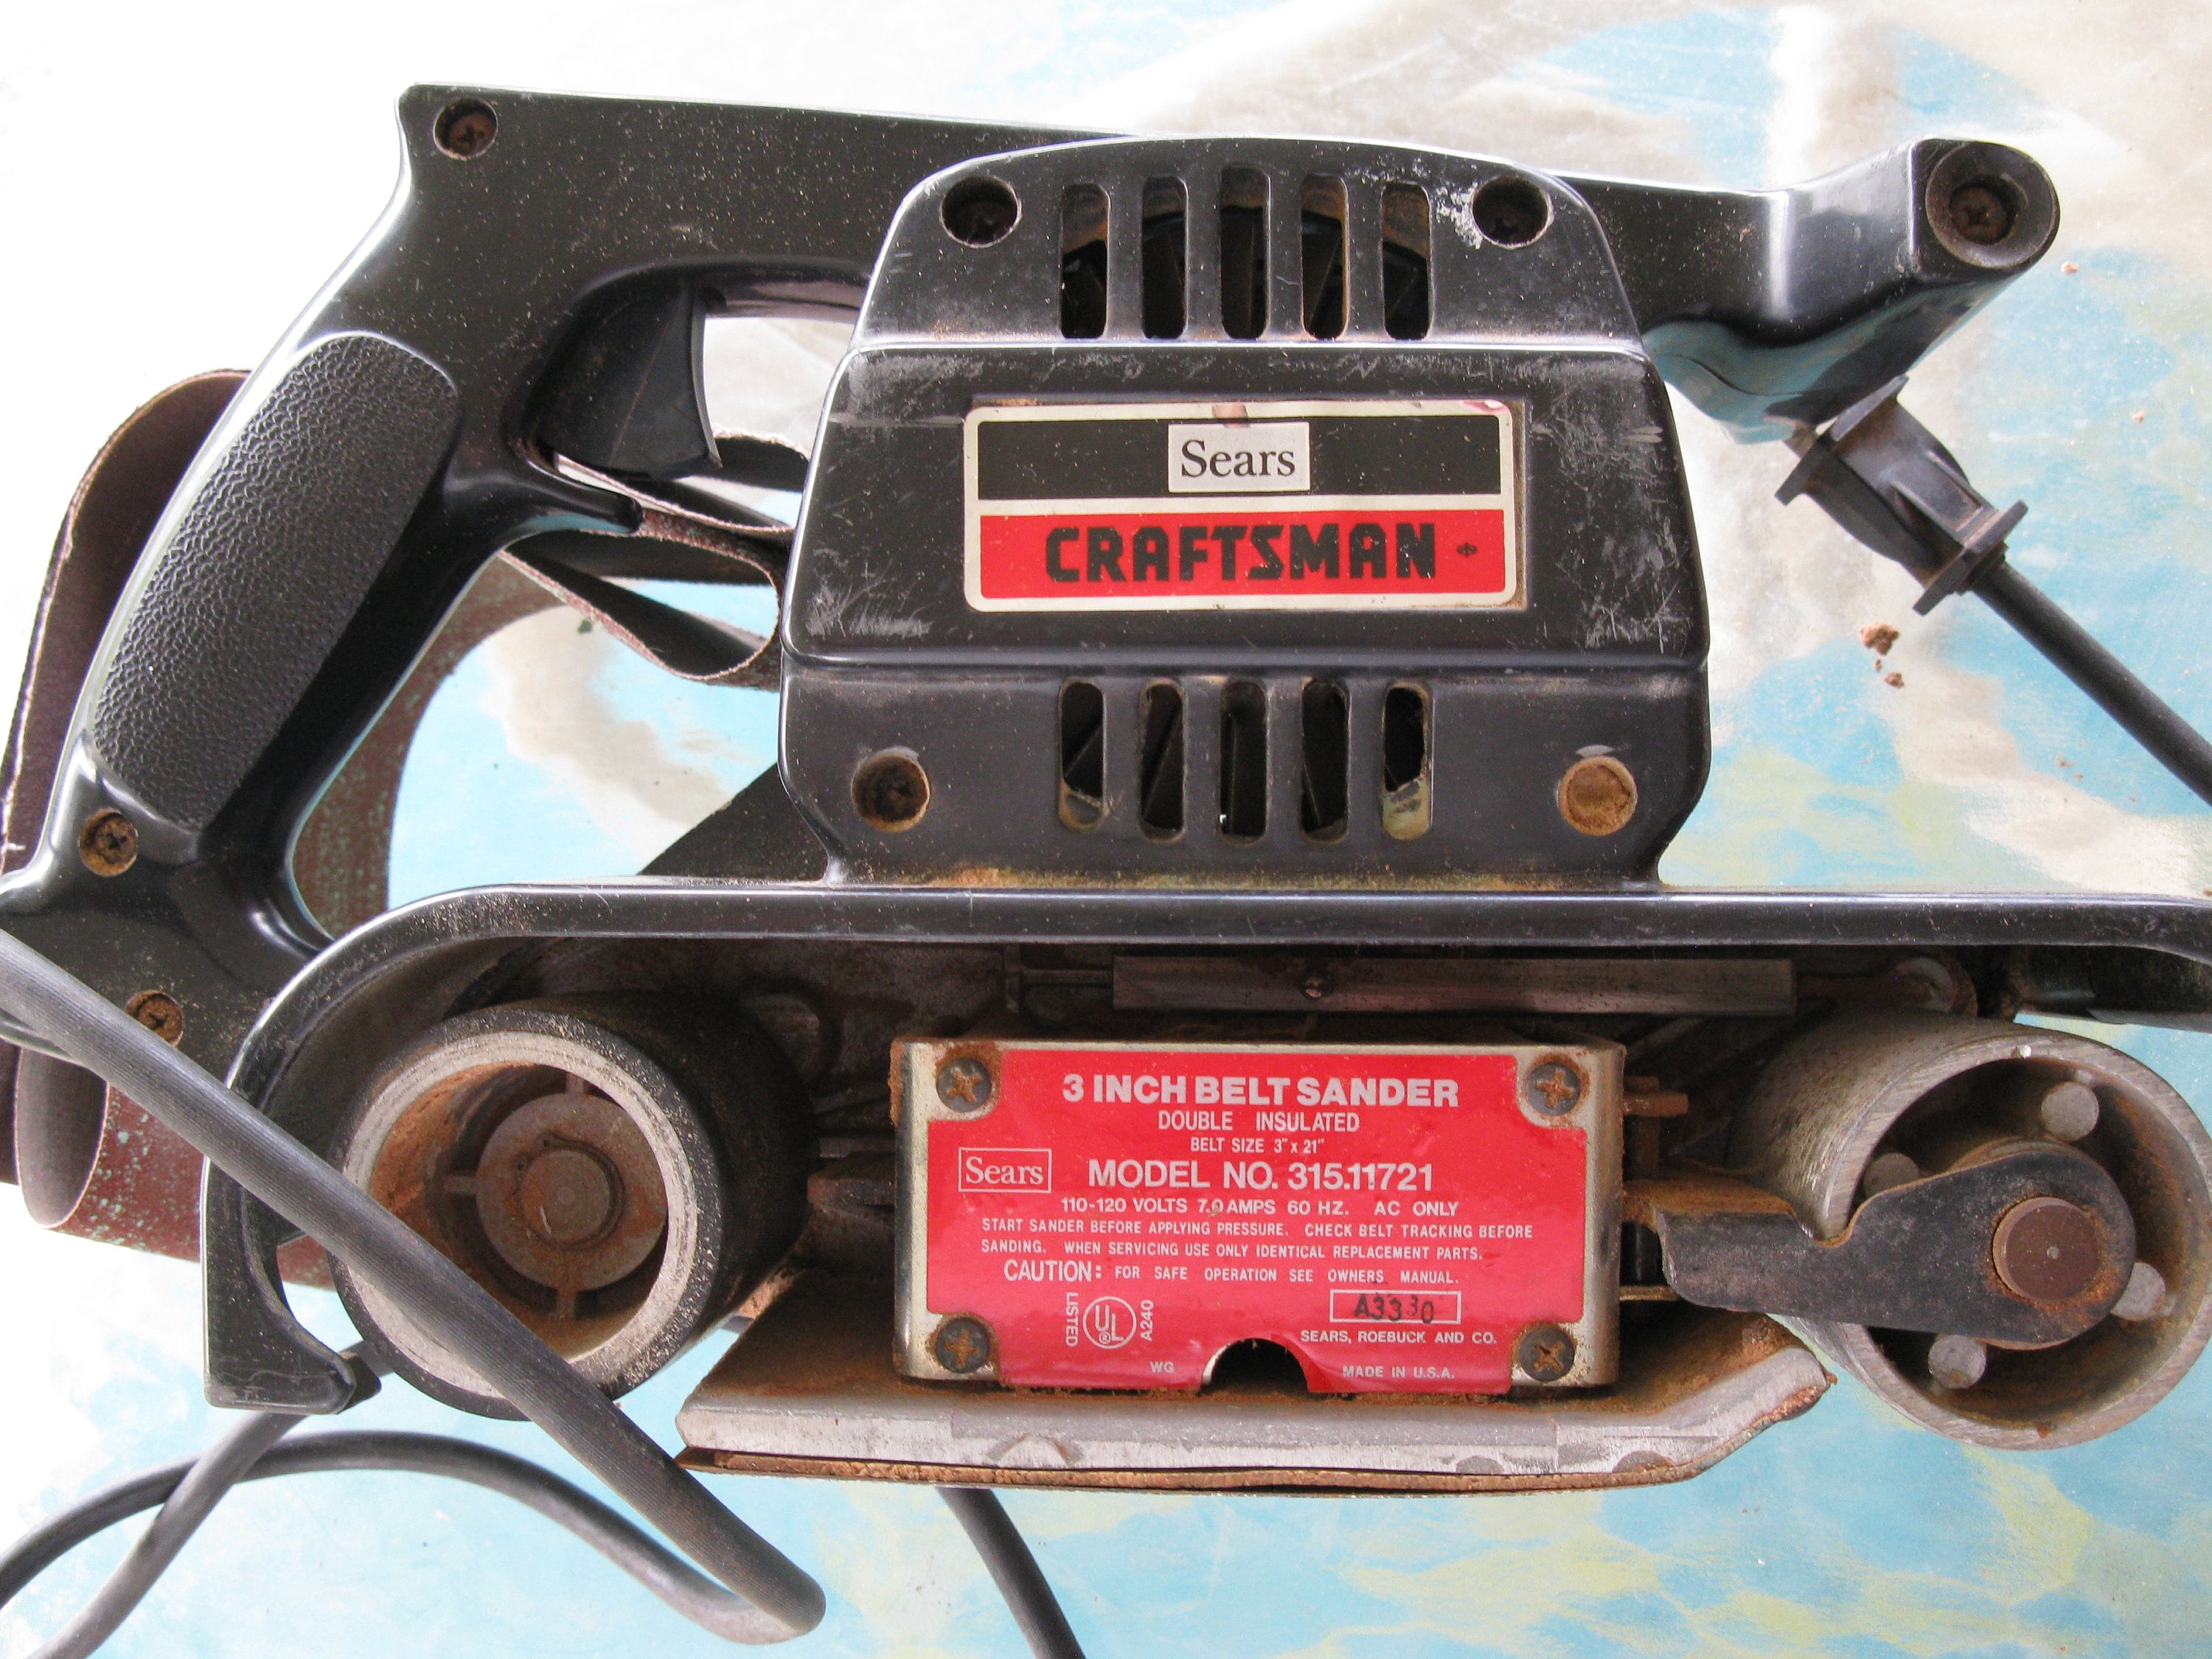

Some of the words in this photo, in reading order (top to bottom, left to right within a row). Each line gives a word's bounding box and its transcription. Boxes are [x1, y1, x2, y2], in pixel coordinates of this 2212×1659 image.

[1181, 440, 1296, 479] Sears
[1046, 524, 1436, 583] CRAFTSMAN
[1062, 1074, 1084, 1102] 3
[1093, 1075, 1186, 1104] INCH
[1195, 1077, 1290, 1106] BELT
[1296, 1077, 1458, 1107] SANDER
[1158, 1110, 1233, 1130] DOUBLE
[1256, 1112, 1360, 1133] INSULATED
[1190, 1138, 1224, 1152] BELT
[1232, 1138, 1264, 1153] SIZE
[1291, 1143, 1298, 1153] x
[965, 1156, 1044, 1185] Sears
[1088, 1159, 1210, 1188] MODEL
[1223, 1161, 1278, 1190] NO.
[1287, 1162, 1432, 1191] 315.11721
[1062, 1198, 1127, 1212] 110-120
[1133, 1198, 1188, 1214] VOLTS
[1227, 1200, 1276, 1215] AMPS
[1287, 1201, 1310, 1215] 60
[1318, 1201, 1349, 1216] HZ.
[1374, 1201, 1400, 1216] AC
[1413, 1201, 1458, 1216] ONLY
[982, 1218, 1023, 1231] START
[1029, 1219, 1083, 1232] SANDER
[1091, 1220, 1141, 1234] BEFORE
[1149, 1222, 1210, 1235] APPLYING
[1217, 1222, 1288, 1236] PRESSURE.
[1305, 1224, 1352, 1237] CHECK
[1359, 1225, 1393, 1237] BELT
[1401, 1225, 1472, 1238] TRACKING
[1479, 1225, 1532, 1238] BEFORE
[981, 1239, 1046, 1253] SANDING.
[1064, 1242, 1101, 1254] WHEN
[1108, 1242, 1178, 1256] SERVICING
[1185, 1244, 1209, 1256] USE
[1216, 1245, 1248, 1258] ONLY
[1256, 1245, 1325, 1258] IDENTICAL
[1333, 1246, 1430, 1259] REPLACEMENT
[1436, 1247, 1482, 1260] PARTS.
[1004, 1259, 1102, 1281] CAUTION:
[1115, 1266, 1140, 1279] FOR
[1154, 1266, 1187, 1279] SAFE
[1204, 1267, 1277, 1281] OPERATION
[1289, 1269, 1313, 1282] SEE
[1328, 1270, 1384, 1283] OWNERS
[1401, 1270, 1458, 1284] MANUAL.
[1065, 1292, 1079, 1346] LISTED
[1140, 1299, 1153, 1341] A240
[1301, 1331, 1351, 1344] SEARS,
[1358, 1331, 1425, 1343] ROEBUCK
[1435, 1332, 1464, 1343] AND
[1472, 1332, 1497, 1343] CO.
[1150, 1361, 1175, 1373] WG
[1343, 1366, 1383, 1377] MADE
[1392, 1367, 1405, 1377] IN
[1414, 1367, 1455, 1379] U.S.A.
